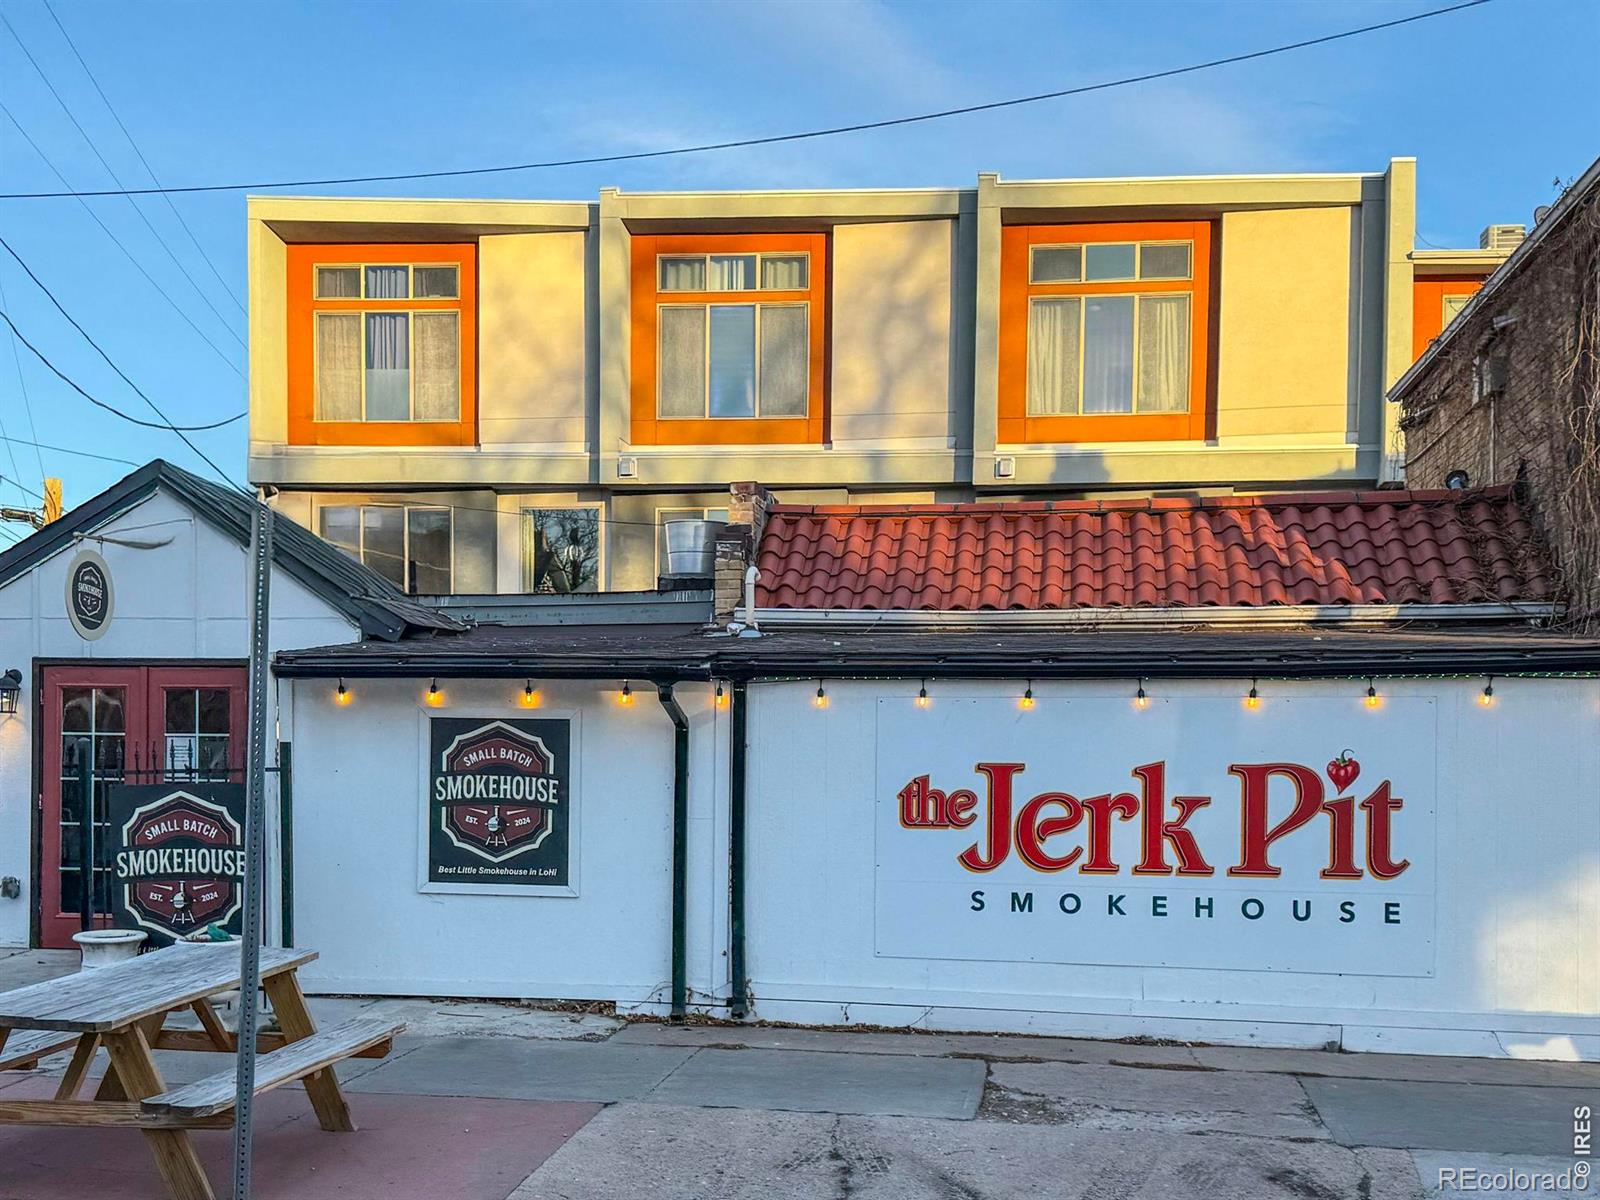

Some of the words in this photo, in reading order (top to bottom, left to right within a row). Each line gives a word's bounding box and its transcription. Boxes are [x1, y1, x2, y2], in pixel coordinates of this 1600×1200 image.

[463, 748, 497, 767] SMALL
[500, 748, 533, 767] BATCH
[435, 774, 559, 804] SMOKEHOUSE
[465, 815, 478, 825] EST.
[514, 816, 531, 827] 2024
[897, 774, 978, 829] the
[957, 760, 1215, 877] Jerk
[1227, 749, 1411, 880] Pit
[144, 819, 180, 840] SMALL
[183, 819, 218, 840] BATCH
[116, 848, 246, 878] SMOKEHOUSE
[438, 866, 457, 874] Best
[457, 866, 477, 875] Little
[478, 867, 528, 876] Smokehouse
[529, 868, 537, 876] in
[538, 869, 557, 877] LoHi
[150, 892, 163, 902] EST.
[201, 892, 219, 902] 2024
[970, 890, 1402, 925] SMOKEHOUSE
